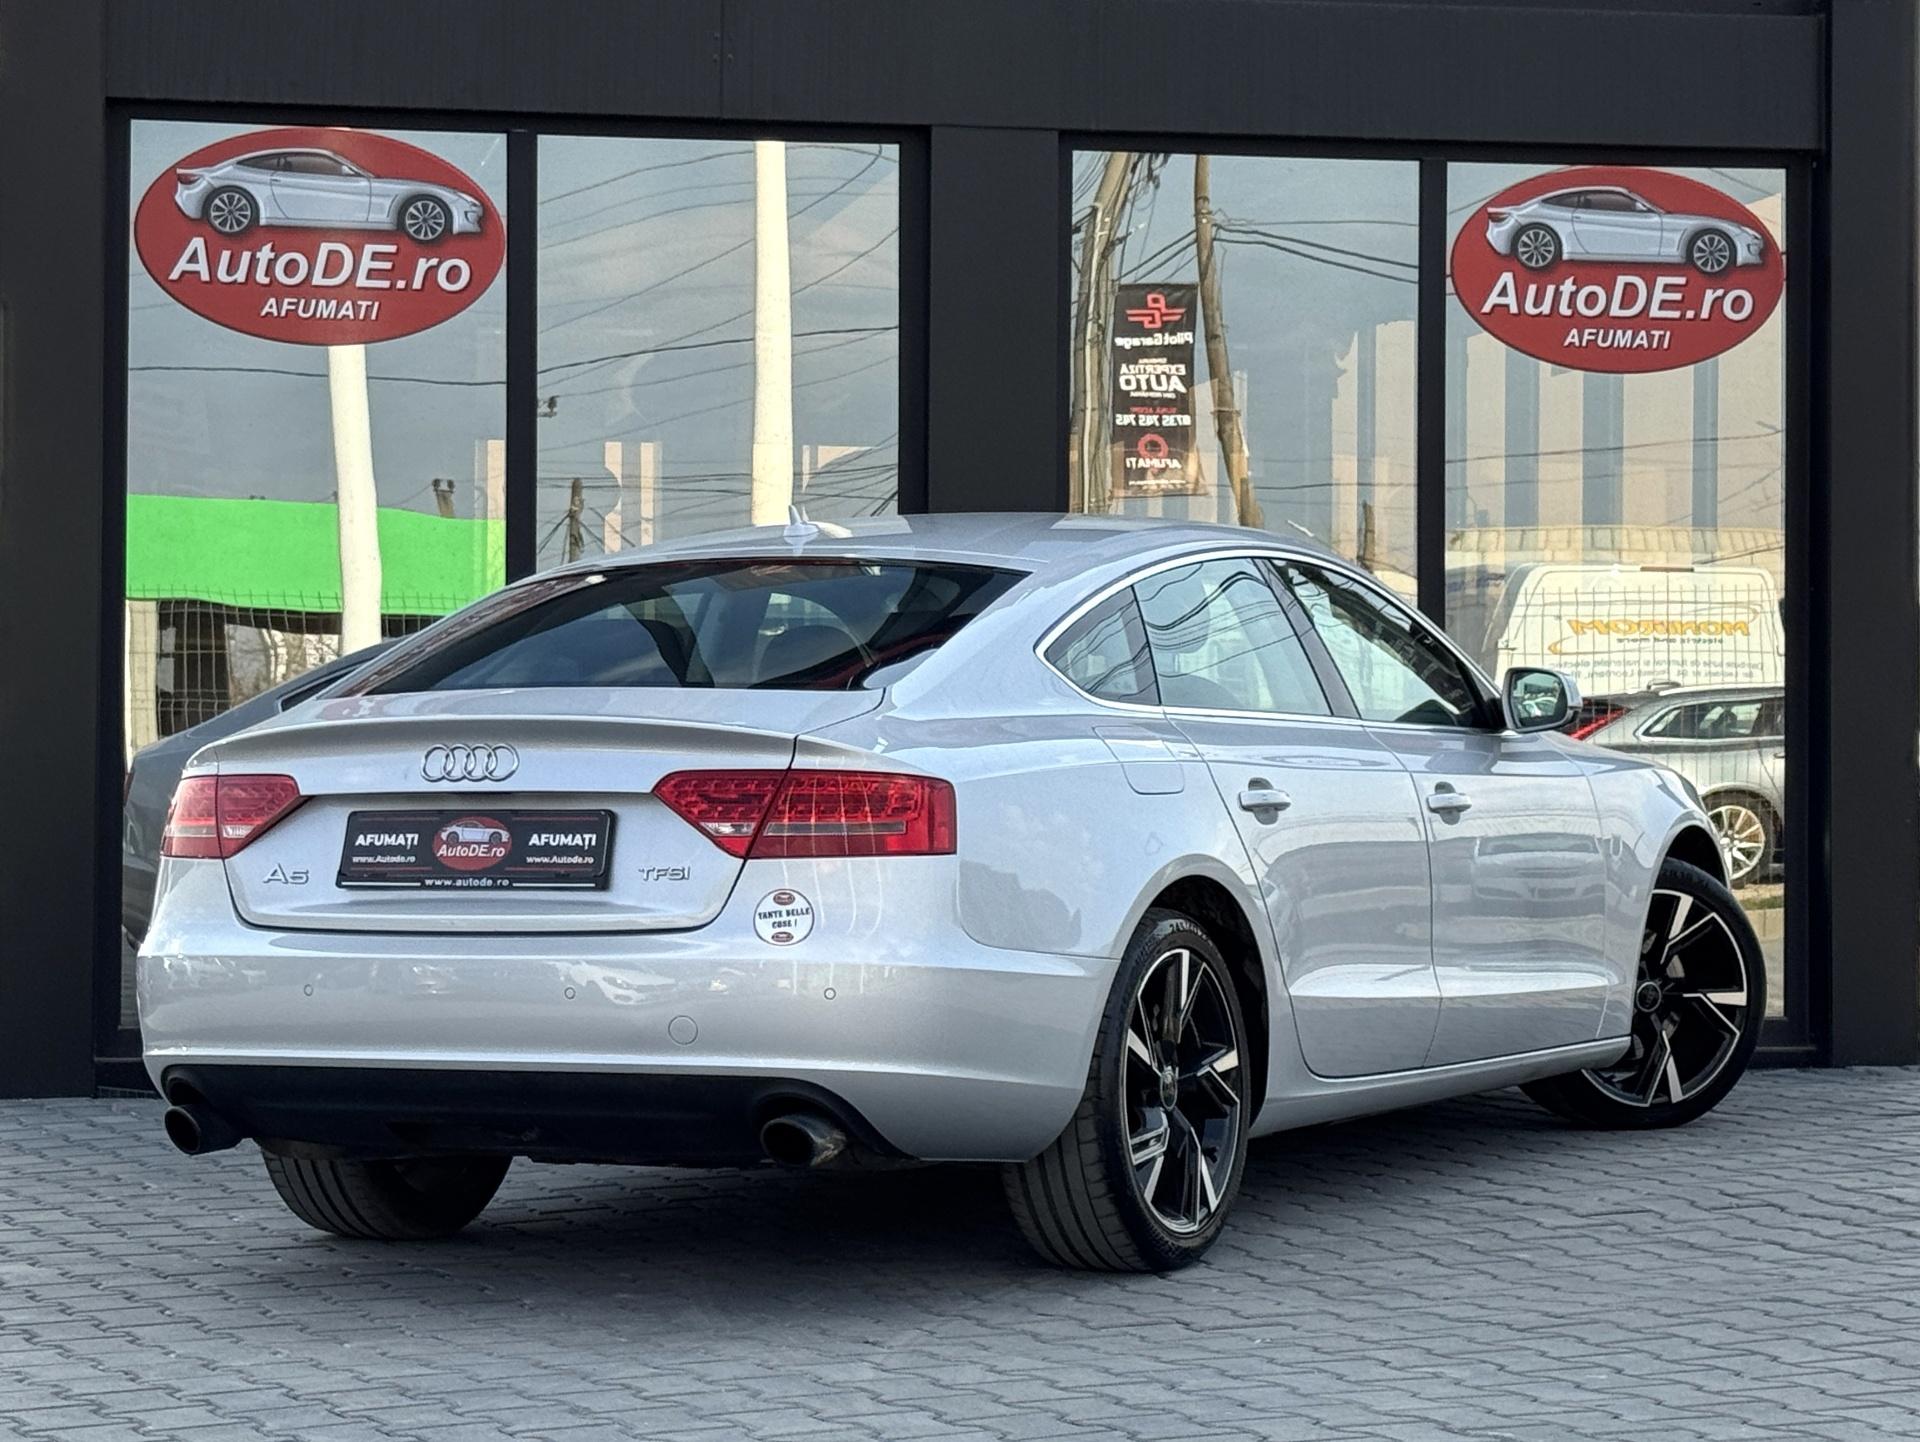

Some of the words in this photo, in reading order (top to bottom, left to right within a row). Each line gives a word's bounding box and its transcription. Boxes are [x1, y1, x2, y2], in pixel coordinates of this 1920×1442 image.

[168, 236, 471, 293] AutoDE.ro
[1480, 271, 1754, 321] AutoDE.ro
[260, 297, 380, 321] AFUMATI
[1563, 327, 1671, 350] AFUMATI
[355, 833, 419, 850] AFUMAȚI
[528, 833, 597, 850] AFUMAȚI
[352, 855, 417, 864] www.Autode.ro
[436, 844, 506, 858] AutoDE.ro
[526, 855, 595, 865] www.Autode.ro
[262, 862, 310, 885] A5
[424, 876, 510, 888] www.autode.ro
[638, 865, 691, 882] TFSI
[757, 909, 784, 920] TANTE
[786, 906, 811, 918] BELLE
